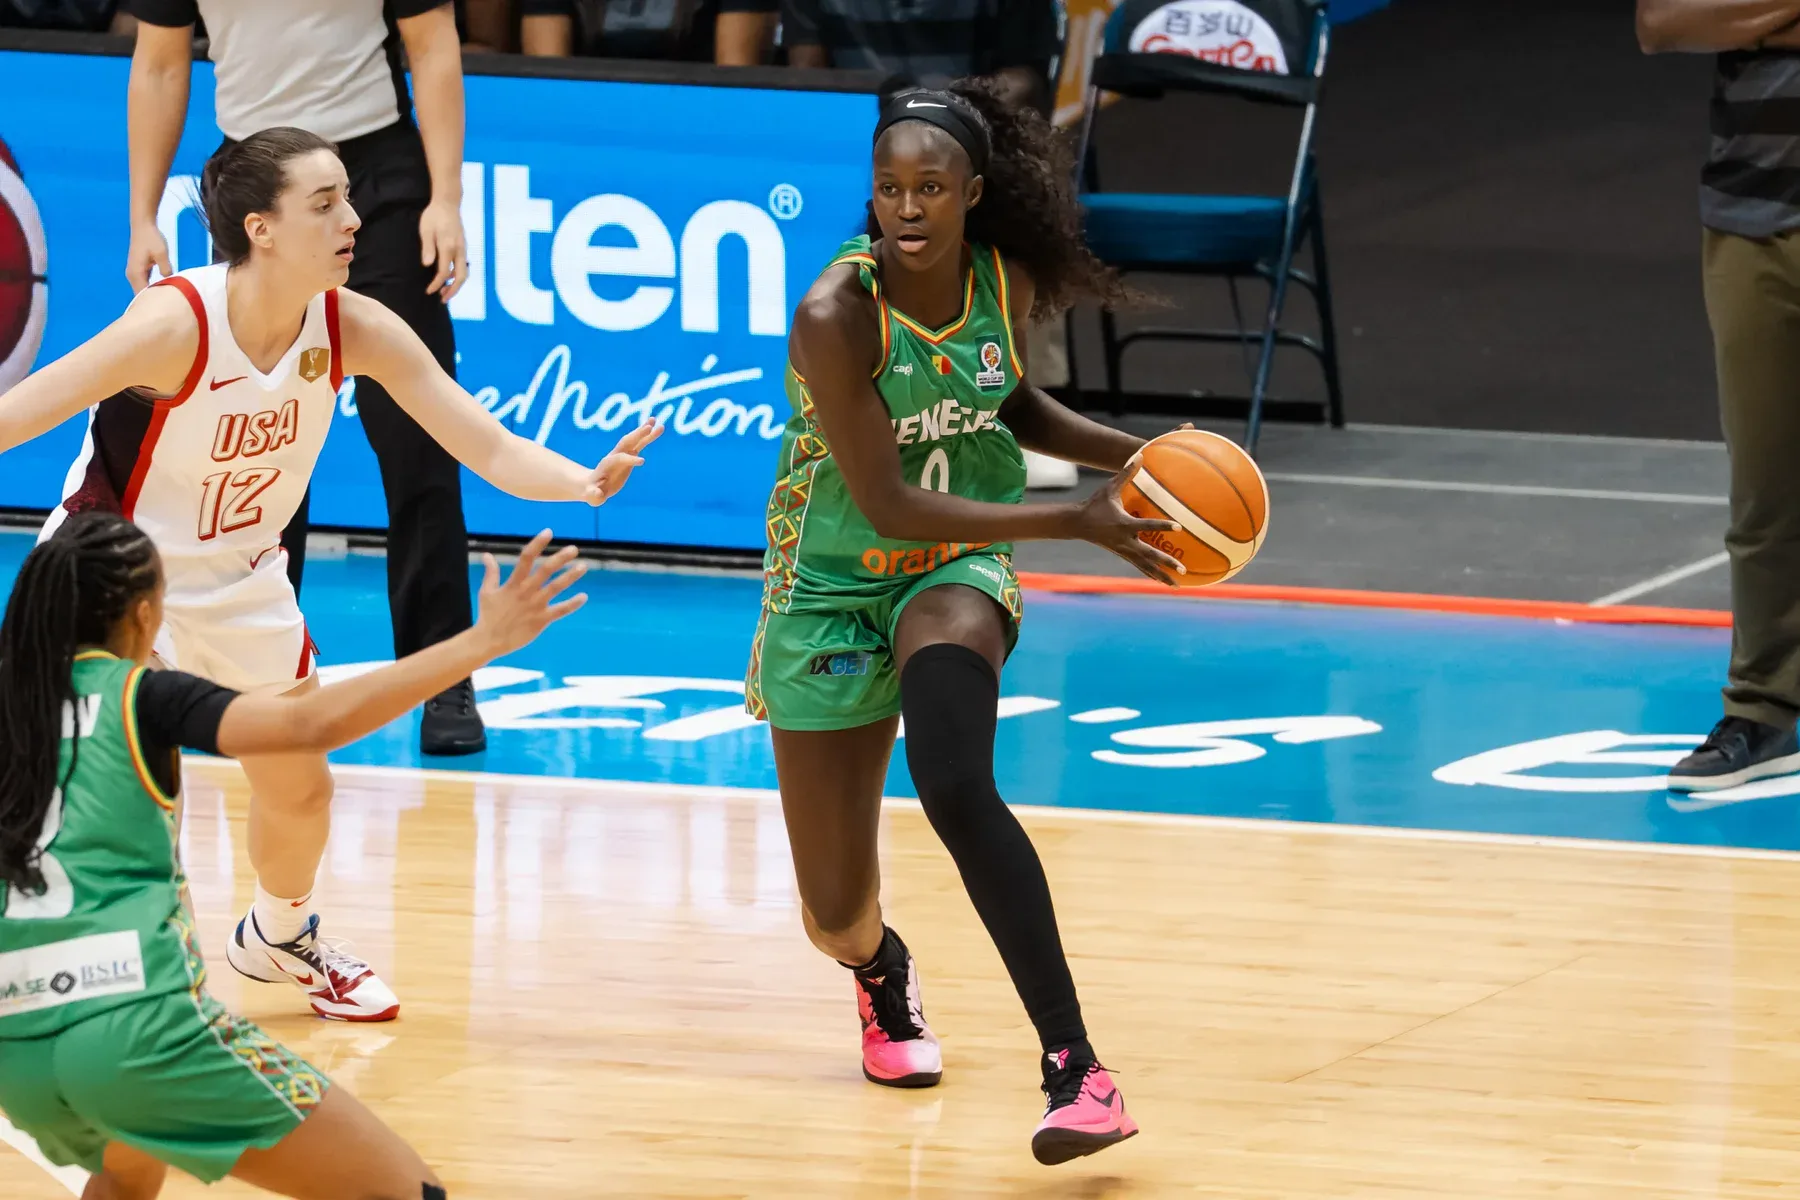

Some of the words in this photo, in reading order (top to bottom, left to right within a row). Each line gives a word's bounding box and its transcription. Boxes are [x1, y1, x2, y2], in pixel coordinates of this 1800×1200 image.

[211, 399, 298, 462] USA
[198, 467, 281, 541] 12
[862, 542, 993, 575] oran
[809, 652, 872, 676] 1XBET
